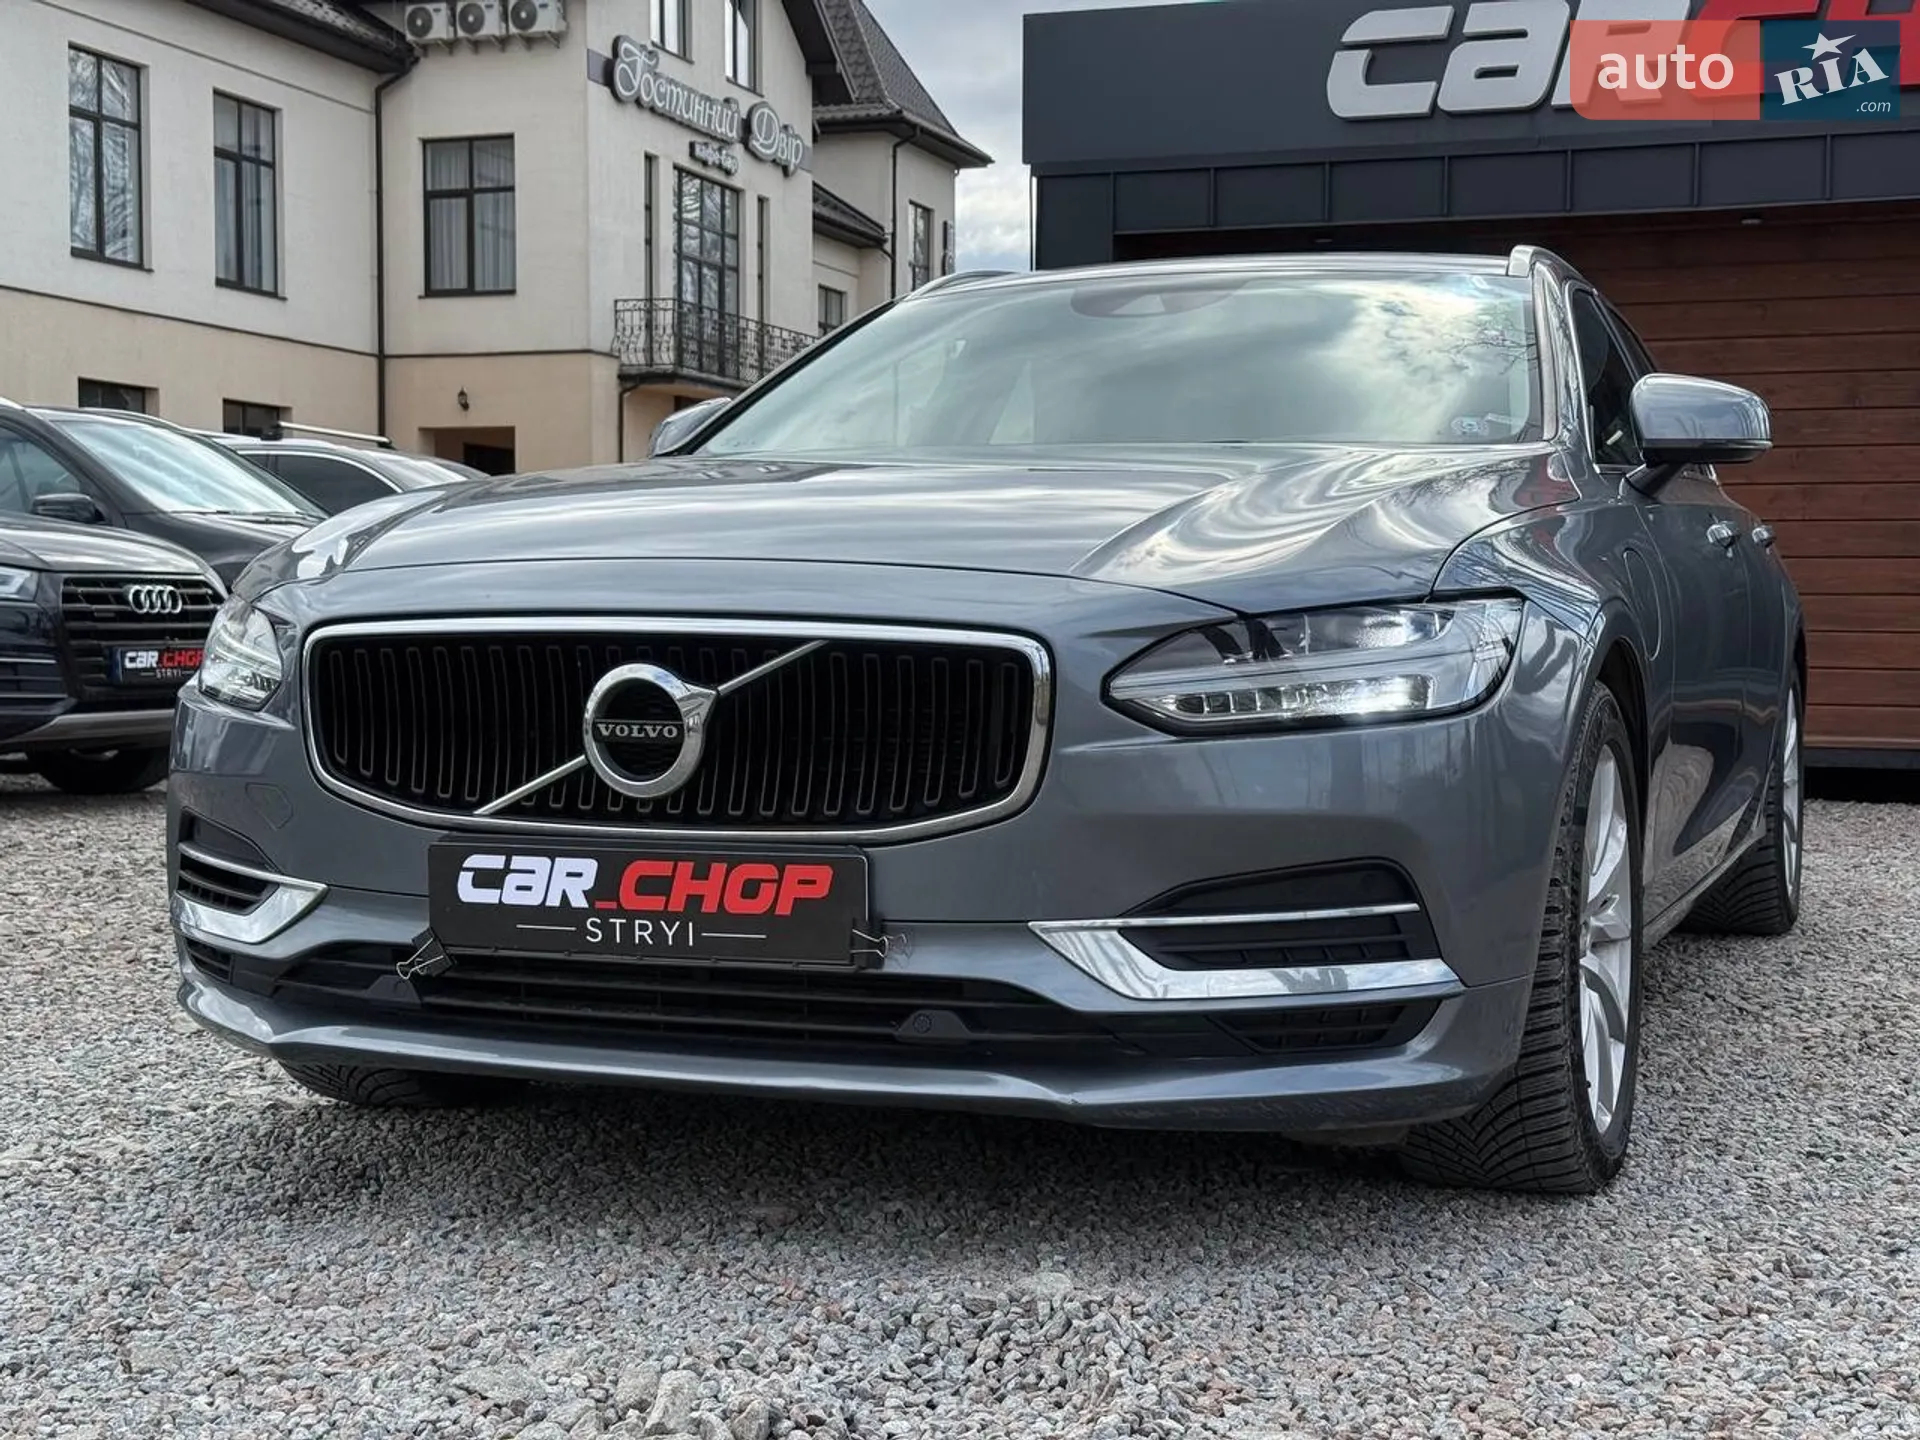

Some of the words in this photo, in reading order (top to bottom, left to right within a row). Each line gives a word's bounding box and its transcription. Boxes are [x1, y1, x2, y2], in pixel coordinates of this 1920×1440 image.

[616, 42, 739, 138] Гостинний
[751, 107, 803, 168] Двір
[156, 669, 182, 679] STRYI
[597, 723, 678, 738] VOLVO
[586, 918, 694, 947] STRYI
